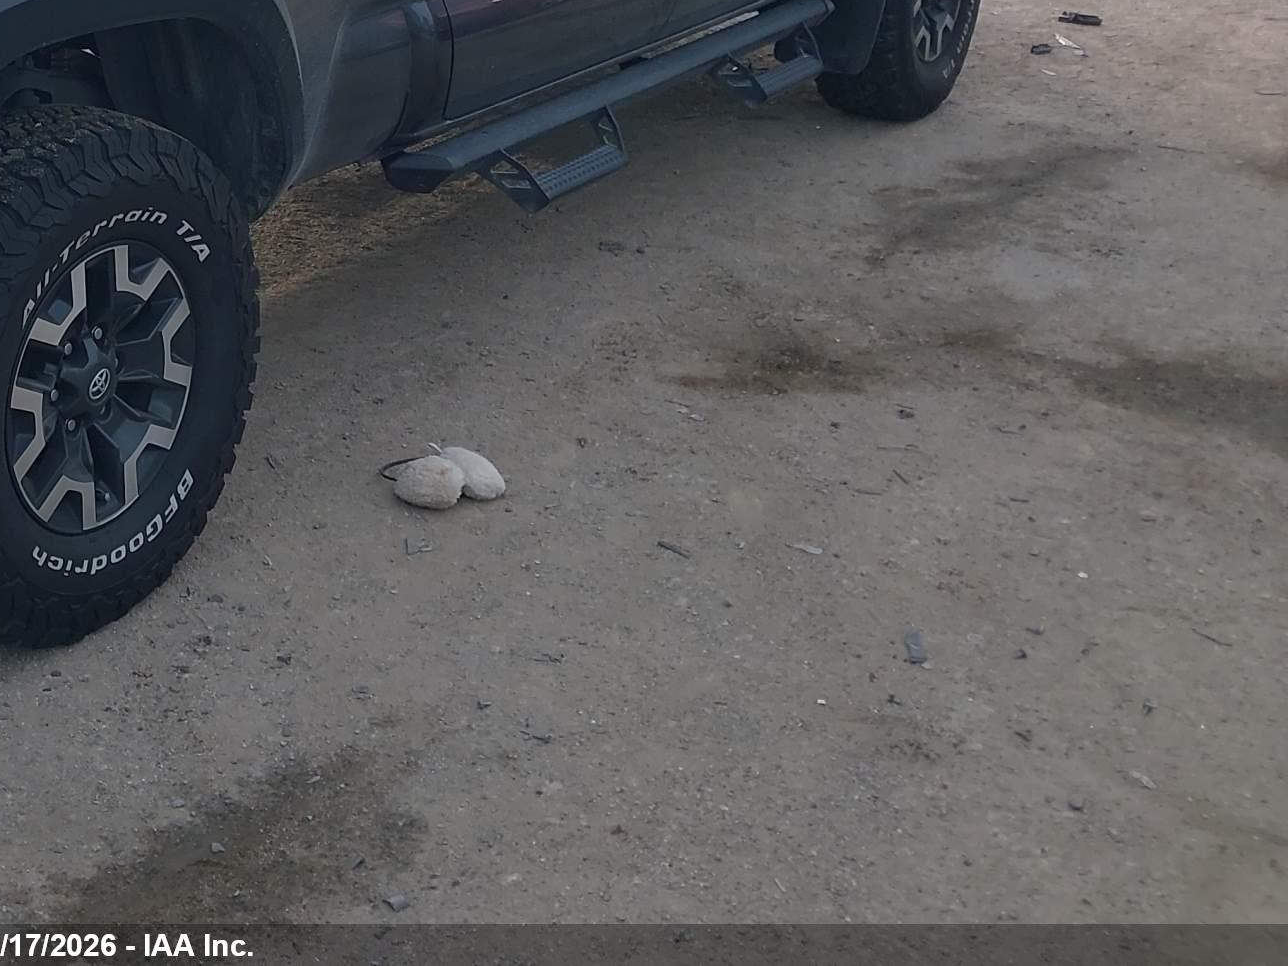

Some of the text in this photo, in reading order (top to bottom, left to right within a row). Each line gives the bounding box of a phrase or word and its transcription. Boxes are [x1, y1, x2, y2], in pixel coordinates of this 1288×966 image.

[22, 206, 212, 330] All-Terrain T/A
[32, 467, 194, 577] BFGoodrich
